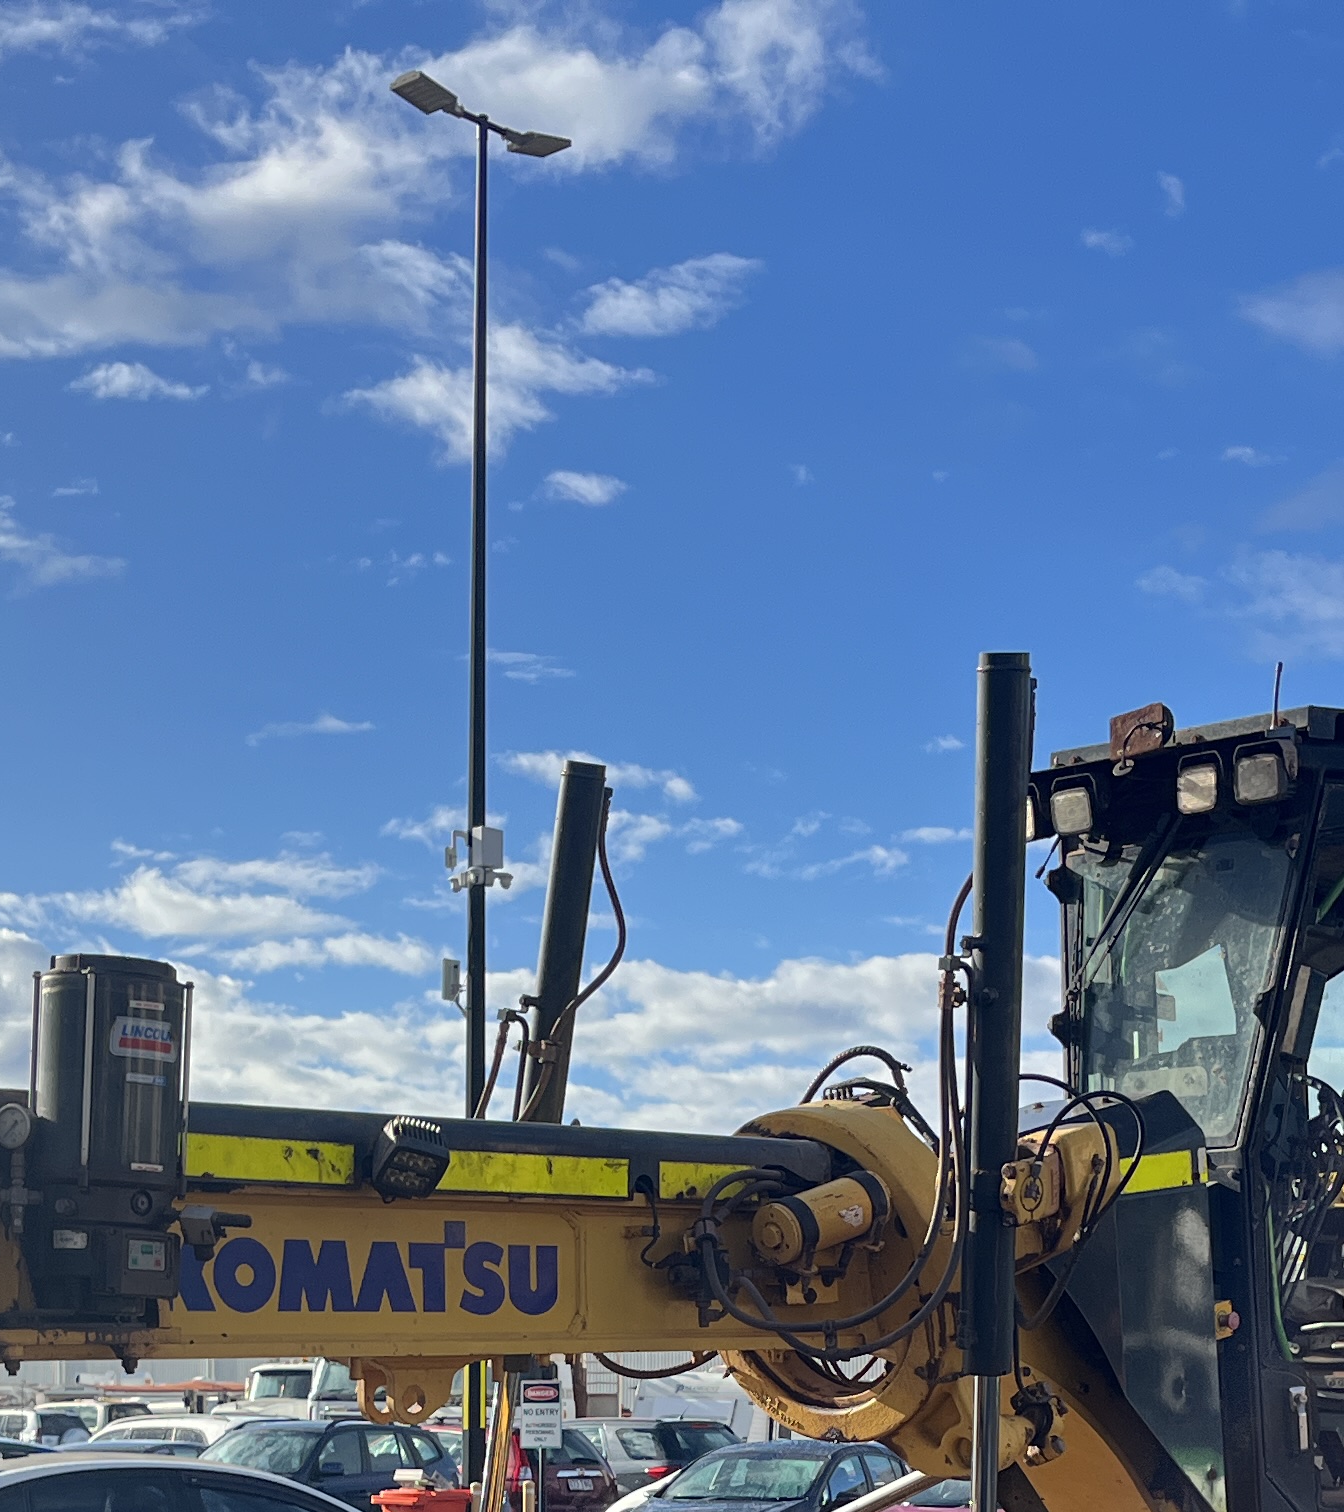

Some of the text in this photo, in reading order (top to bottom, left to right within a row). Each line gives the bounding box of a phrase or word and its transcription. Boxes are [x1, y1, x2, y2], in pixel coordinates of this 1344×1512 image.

[172, 1220, 558, 1316] KOMATSU
[523, 1408, 560, 1416] NO ENTRY
